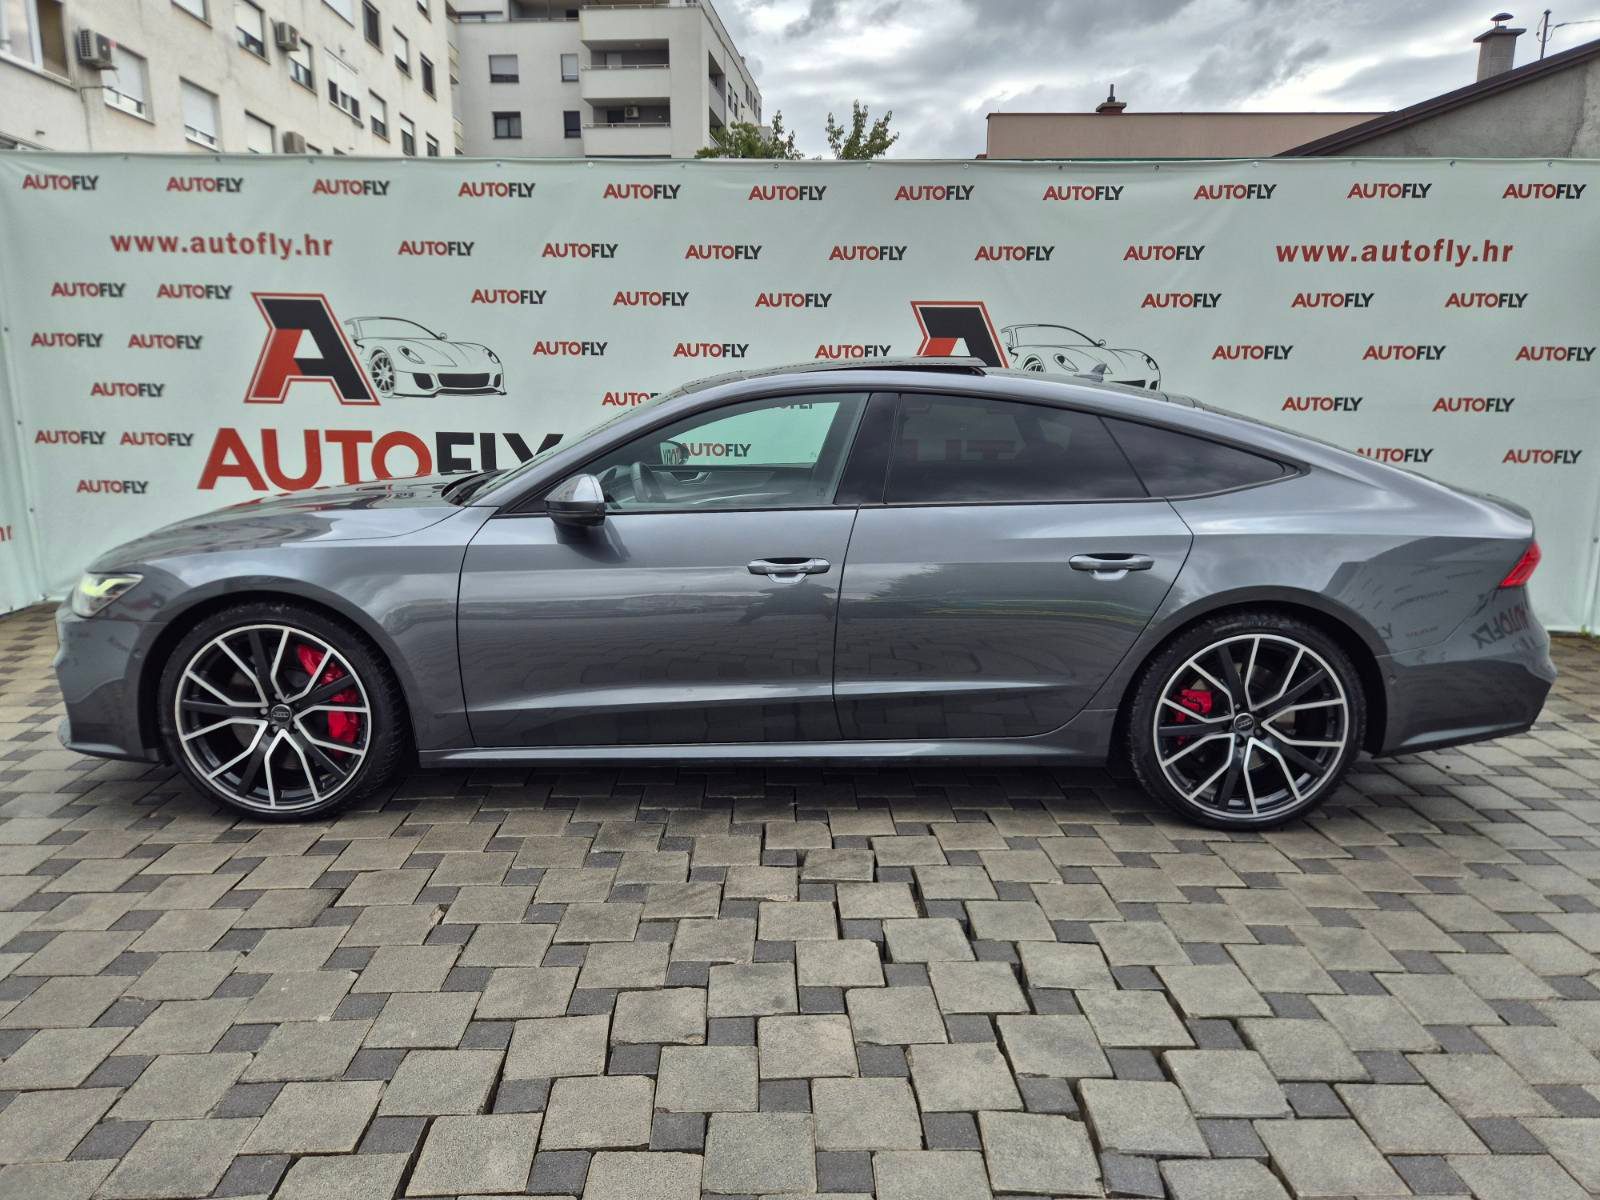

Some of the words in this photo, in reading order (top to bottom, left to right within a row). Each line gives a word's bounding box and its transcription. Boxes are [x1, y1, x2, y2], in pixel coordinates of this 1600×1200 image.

[23, 175, 98, 190] AUTOFLY
[167, 177, 243, 192] AUTOFLY
[313, 180, 390, 195] AUTOFLY
[459, 183, 535, 198] AUTOFLY
[604, 184, 681, 199] AUTOFLY
[749, 186, 827, 200] AUTOFLY
[894, 185, 974, 200] AUTOFLY
[1043, 186, 1124, 200] AUTOFLY
[1194, 184, 1277, 200] AUTOFLY
[1347, 183, 1432, 198] AUTOFLY
[1502, 184, 1587, 199] AUTOFLY
[111, 233, 332, 260] www.autofly.hr
[398, 241, 474, 256] AUTOFLY
[542, 243, 618, 258] AUTOFLY
[685, 245, 762, 259] AUTOFLY
[829, 246, 907, 260] AUTOFLY
[975, 246, 1055, 261] AUTOFLY
[1123, 245, 1205, 260] AUTOFLY
[1276, 239, 1513, 267] www.autofly.hr
[52, 283, 125, 297] AUTOFLY
[158, 284, 232, 299] AUTOFLY
[472, 289, 547, 304] AUTOFLY
[613, 292, 689, 306] AUTOFLY
[755, 293, 832, 307] AUTOFLY
[1141, 293, 1222, 308] AUTOFLY
[1291, 293, 1374, 308] AUTOFLY
[1445, 293, 1528, 308] AUTOFLY
[31, 333, 103, 347] AUTOFLY
[128, 335, 202, 349] AUTOFLY
[533, 342, 607, 355] AUTOFLY
[674, 343, 749, 357] AUTOFLY
[815, 345, 891, 359] AUTOFLY
[1212, 345, 1293, 360] AUTOFLY
[1363, 346, 1446, 360] AUTOFLY
[1515, 346, 1596, 362] AUTOFLY
[91, 383, 164, 397] AUTOFLY
[601, 391, 660, 406] AUTO
[1282, 397, 1363, 411] AUTOFLY
[1432, 398, 1515, 412] AUTOFLY
[35, 430, 106, 444] AUTOFLY
[121, 432, 193, 446] AUTOFLY
[1502, 449, 1582, 464] AUTOFLY
[77, 480, 148, 494] AUTOFLY
